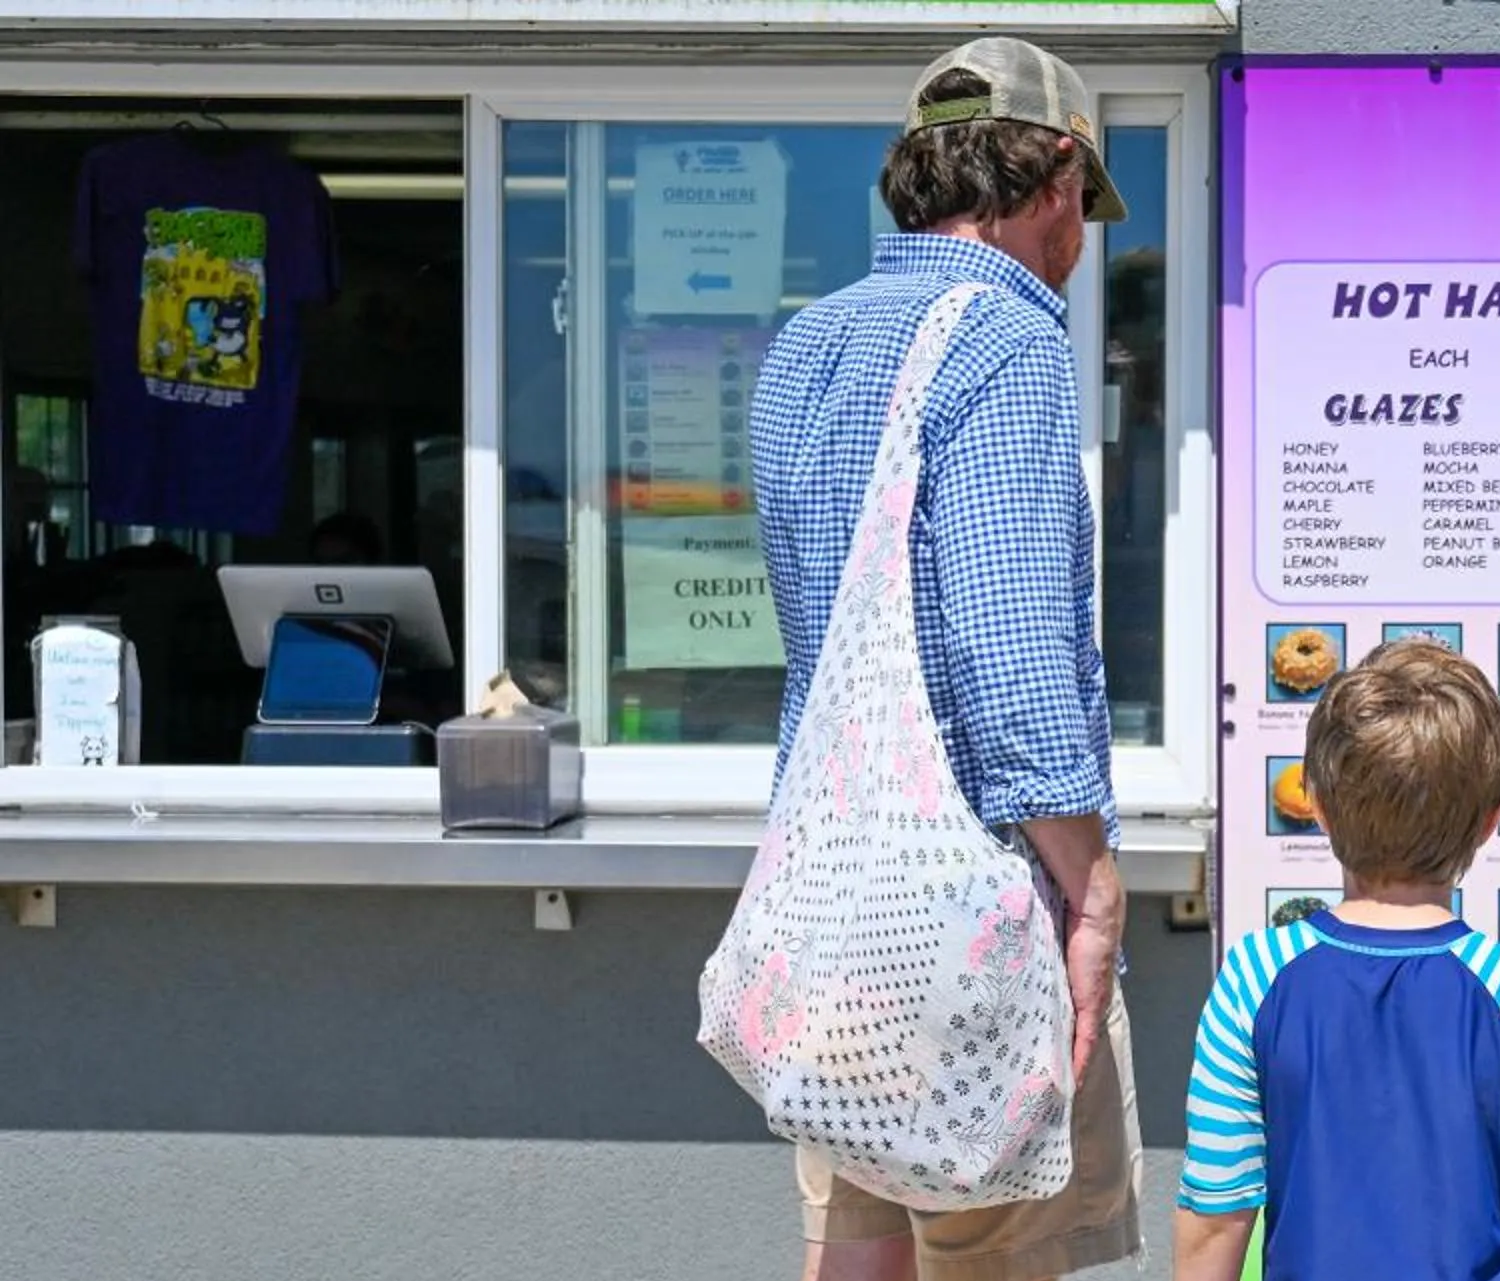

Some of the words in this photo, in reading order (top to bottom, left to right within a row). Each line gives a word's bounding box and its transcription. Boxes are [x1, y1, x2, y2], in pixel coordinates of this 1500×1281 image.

[662, 186, 716, 202] ORDER
[719, 186, 757, 202] HERE
[1333, 282, 1432, 319] HOT
[1410, 348, 1469, 368] EACH
[1324, 394, 1462, 426] GLAZES
[1282, 441, 1340, 457] HONEY
[1282, 460, 1348, 475] BANANA
[1423, 460, 1479, 475] MOCHA
[1282, 479, 1375, 495] CHOCOLATE
[1423, 479, 1476, 495] MIXED
[1282, 498, 1333, 513] MAPLE
[1282, 517, 1343, 532] CHERRY
[1422, 517, 1495, 532] CARAMEL
[1283, 535, 1386, 551] STRAWBERRY
[1423, 536, 1486, 551] PEANUT
[1282, 554, 1339, 569] LEMON
[1422, 554, 1488, 569] ORANGE
[674, 577, 768, 598] CREDIT
[1282, 573, 1369, 589] RASPBERRY
[689, 611, 756, 630] ONLY
